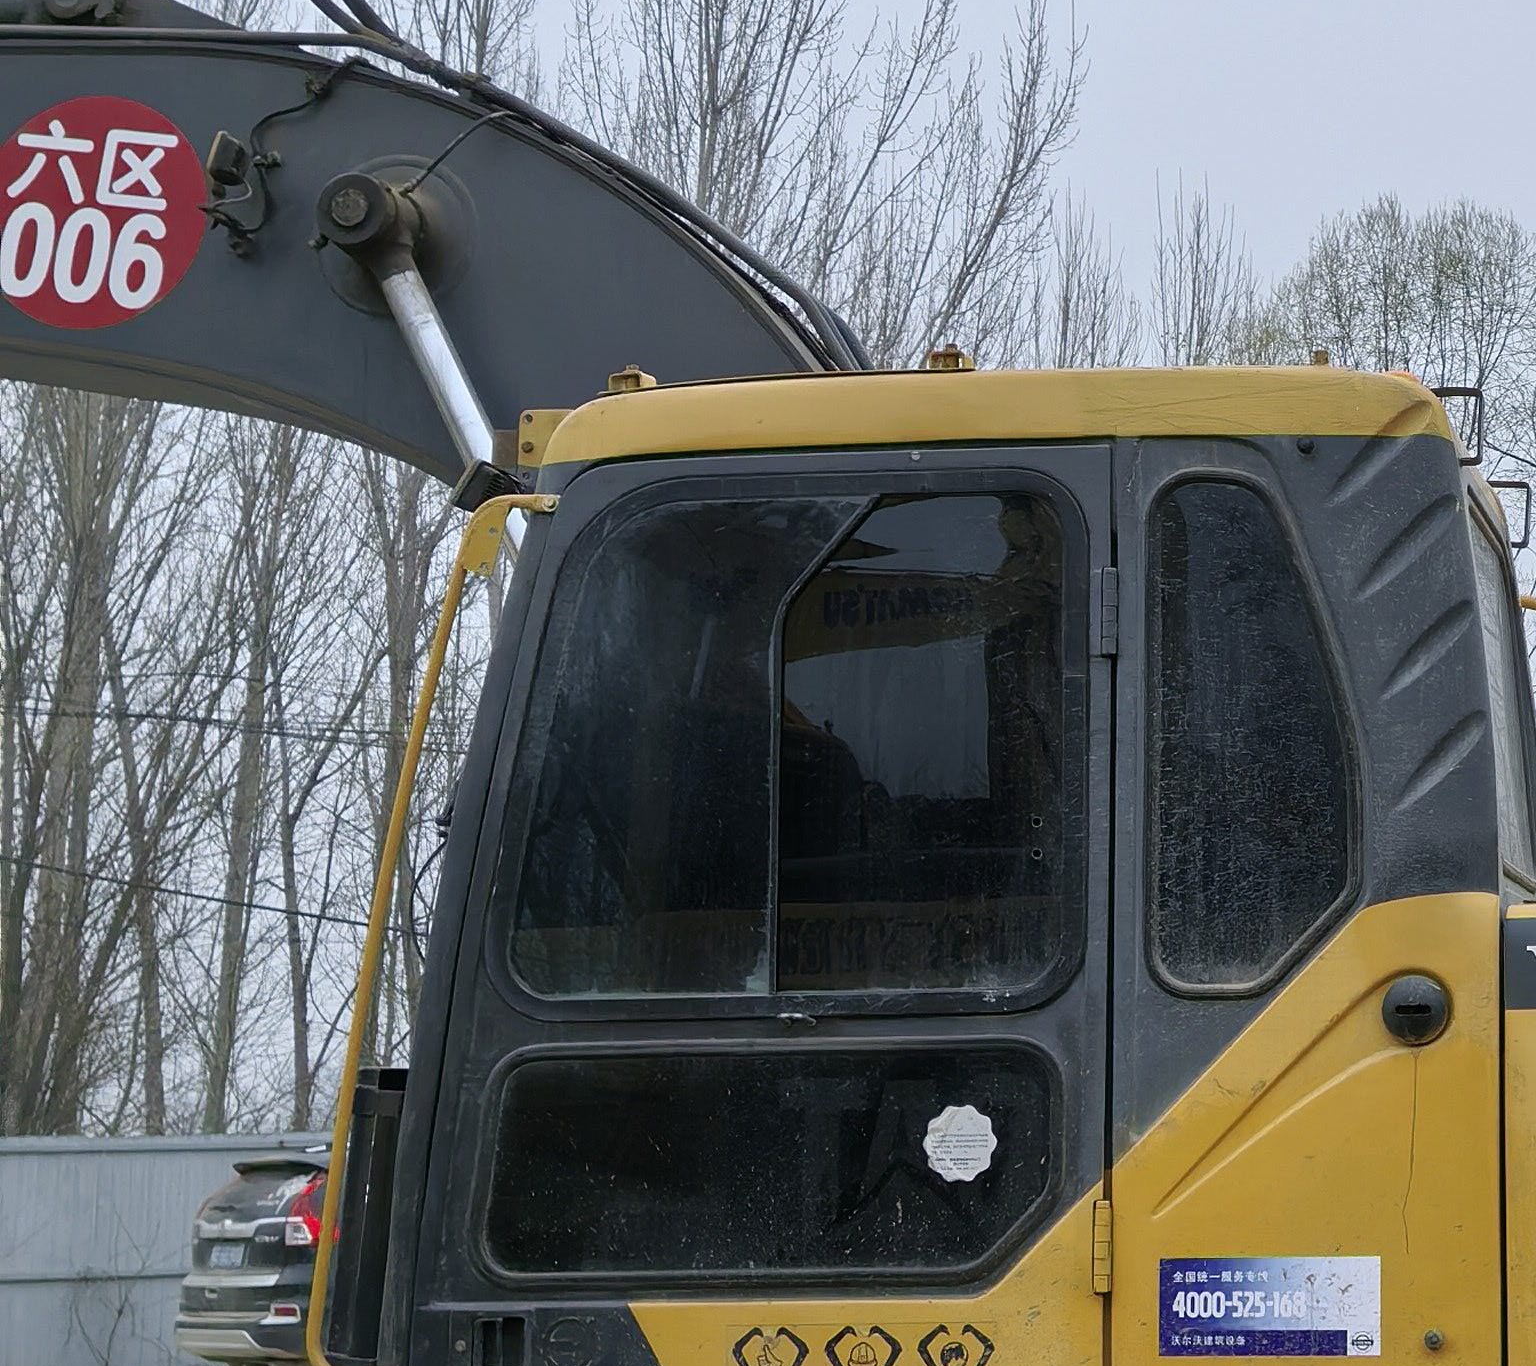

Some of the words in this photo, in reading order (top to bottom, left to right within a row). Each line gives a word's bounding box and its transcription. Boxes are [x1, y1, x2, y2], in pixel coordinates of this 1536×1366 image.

[7, 119, 179, 211] 六区
[0, 201, 166, 310] 006
[1172, 1290, 1307, 1318] 4000-525-168
